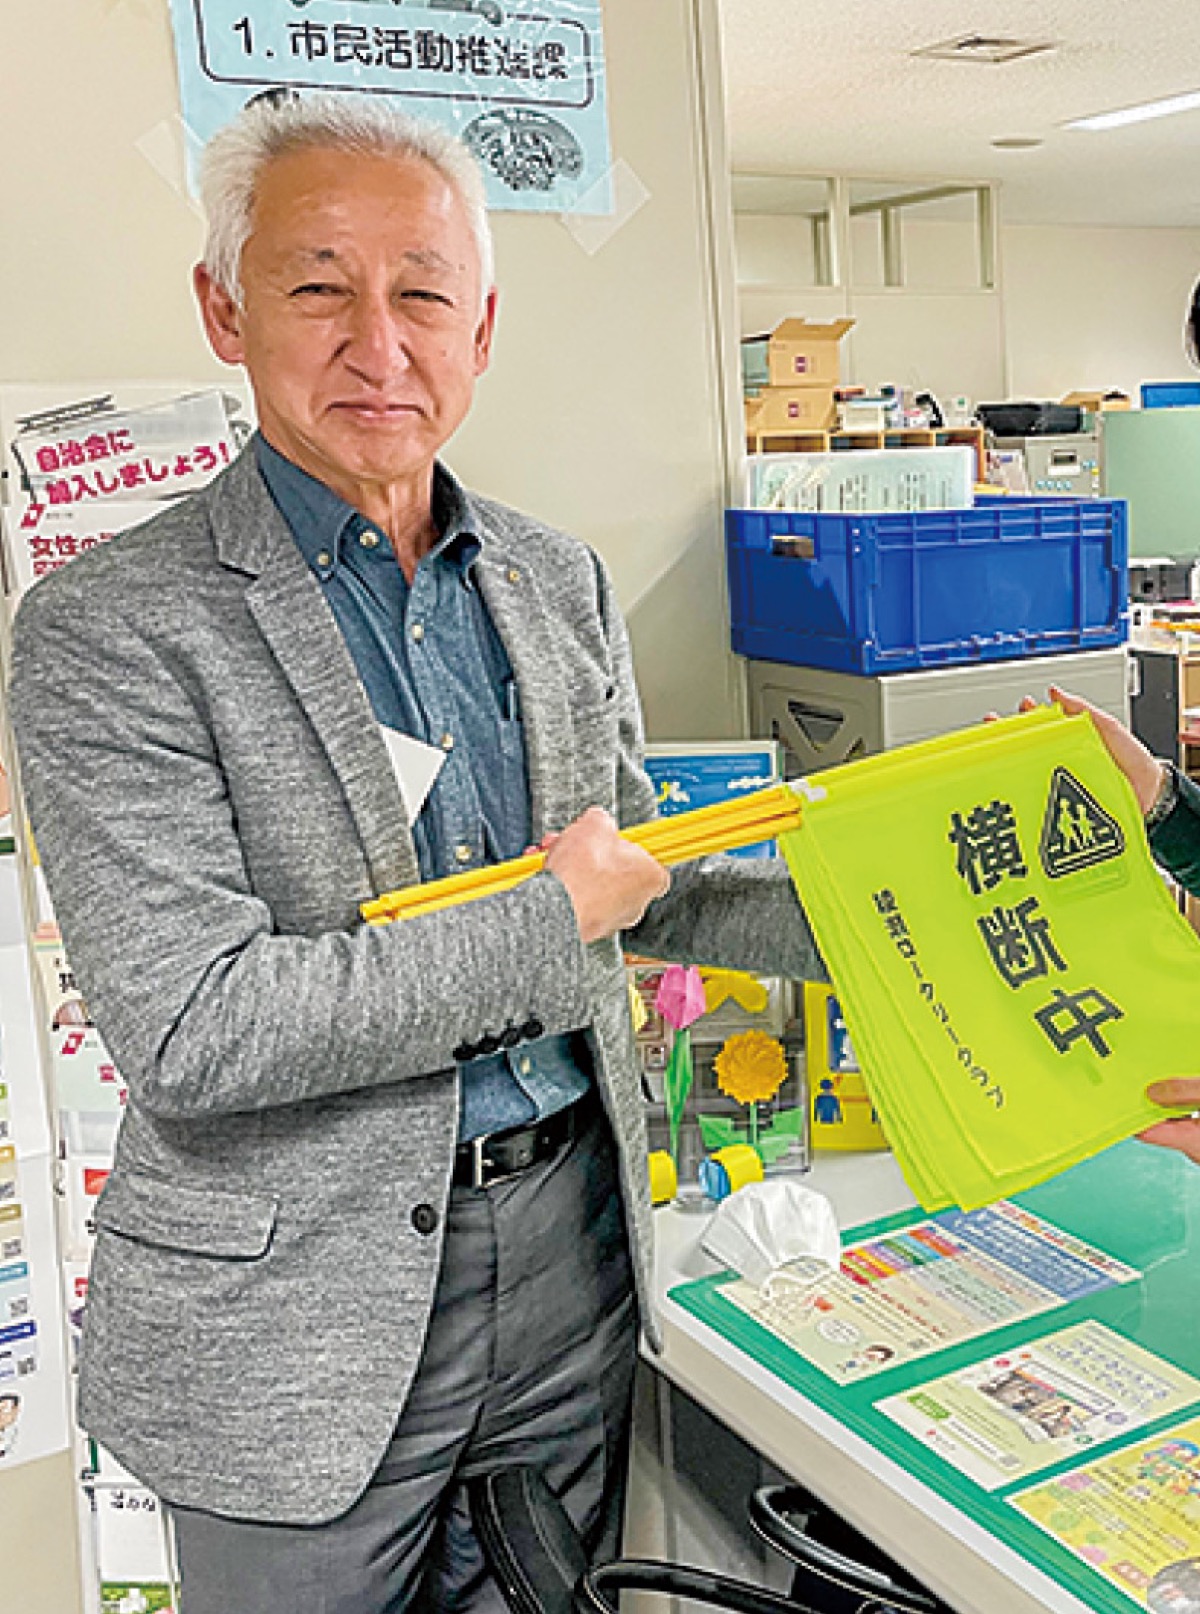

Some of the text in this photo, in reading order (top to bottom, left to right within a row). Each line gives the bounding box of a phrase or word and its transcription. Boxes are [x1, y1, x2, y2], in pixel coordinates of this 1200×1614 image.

[286, 19, 568, 80] 市民活動推進課
[948, 800, 1125, 1058] 横断中
